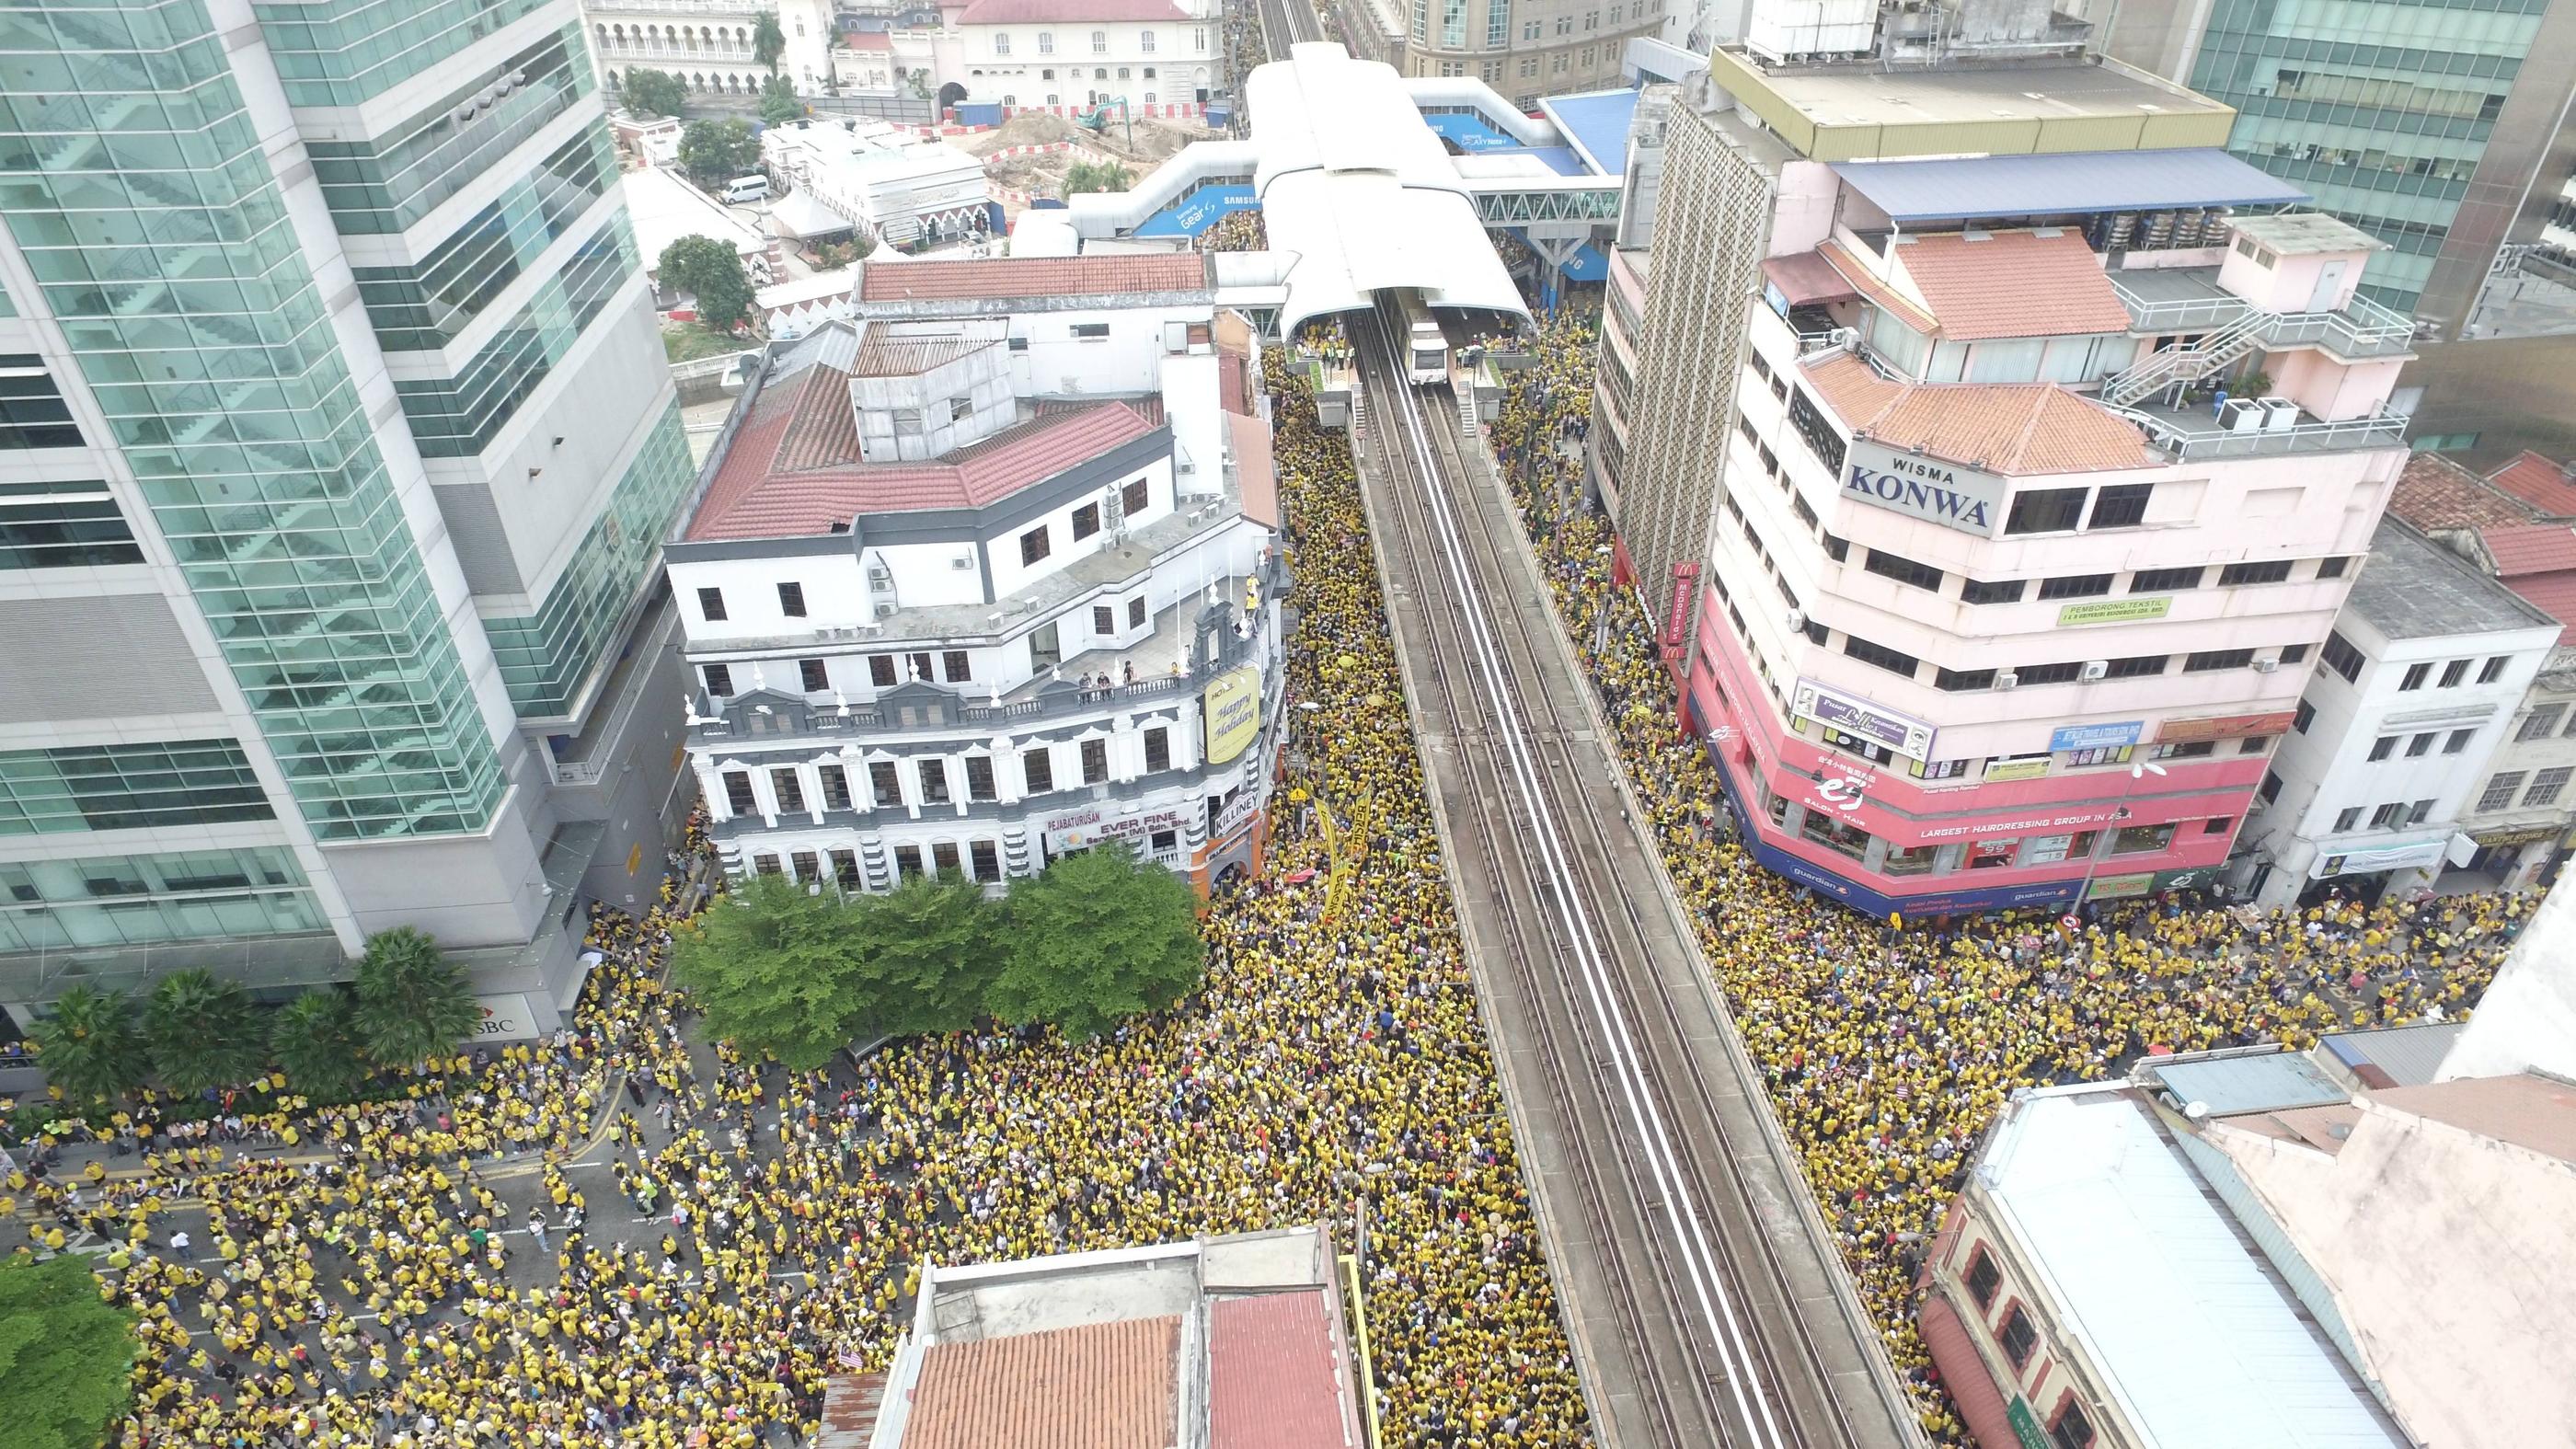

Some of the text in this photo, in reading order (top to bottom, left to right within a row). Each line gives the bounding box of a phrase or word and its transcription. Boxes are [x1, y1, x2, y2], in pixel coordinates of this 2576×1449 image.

[1224, 196, 1261, 204] SAMSUN
[1180, 208, 1203, 229] Gear
[1893, 457, 1953, 484] WISMA
[2070, 600, 2162, 614] PEMBORONG TEKSTIL
[1215, 693, 1251, 721] Happy
[1823, 698, 1846, 712] Pusat
[1213, 708, 1254, 742] Holiday
[1100, 811, 1177, 834] EVER FINE
[1172, 817, 1191, 827] Bhd.
[1215, 792, 1259, 834] KILLINEY
[1843, 812, 1867, 827] HAIR
[1353, 805, 1367, 845] BERSIH
[1920, 826, 1969, 838] LARGEST
[1972, 818, 2050, 834] HAIRDRESSING
[2053, 815, 2091, 825] GROUP
[2093, 813, 2105, 822] IN
[1794, 867, 1836, 890] guardian
[2015, 890, 2057, 901] guardian
[477, 1019, 515, 1035] SBC
